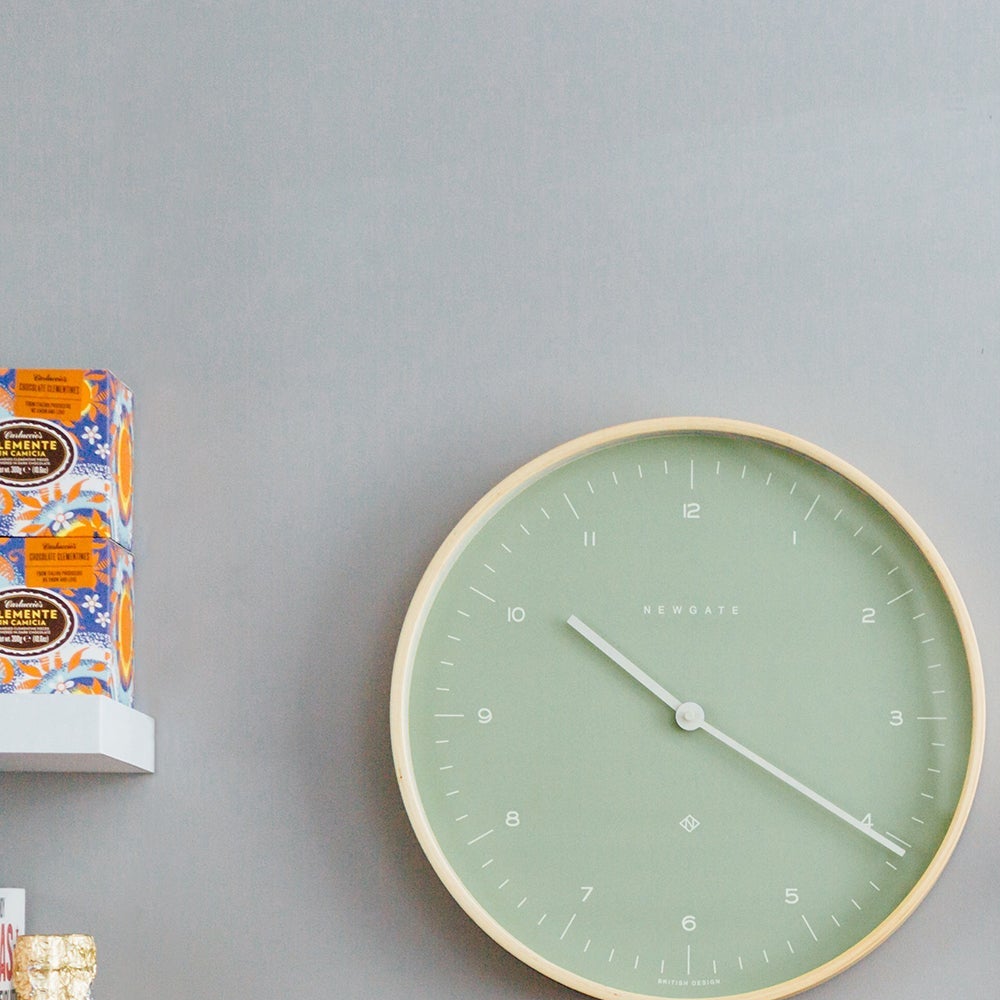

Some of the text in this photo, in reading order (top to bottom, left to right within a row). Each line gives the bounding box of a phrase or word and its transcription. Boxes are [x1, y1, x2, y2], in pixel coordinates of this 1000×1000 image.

[683, 503, 700, 518] 12
[584, 531, 596, 546] 11
[507, 607, 525, 622] 10
[643, 605, 739, 615] NEWGATE
[862, 608, 875, 623] 2
[477, 708, 493, 723] 9
[889, 710, 903, 726] 3
[505, 811, 520, 827] 8
[860, 813, 874, 829] 4
[580, 886, 594, 902] 7
[784, 888, 799, 904] 5
[681, 915, 696, 931] 6
[657, 978, 721, 986] BRITISH DESIGN
